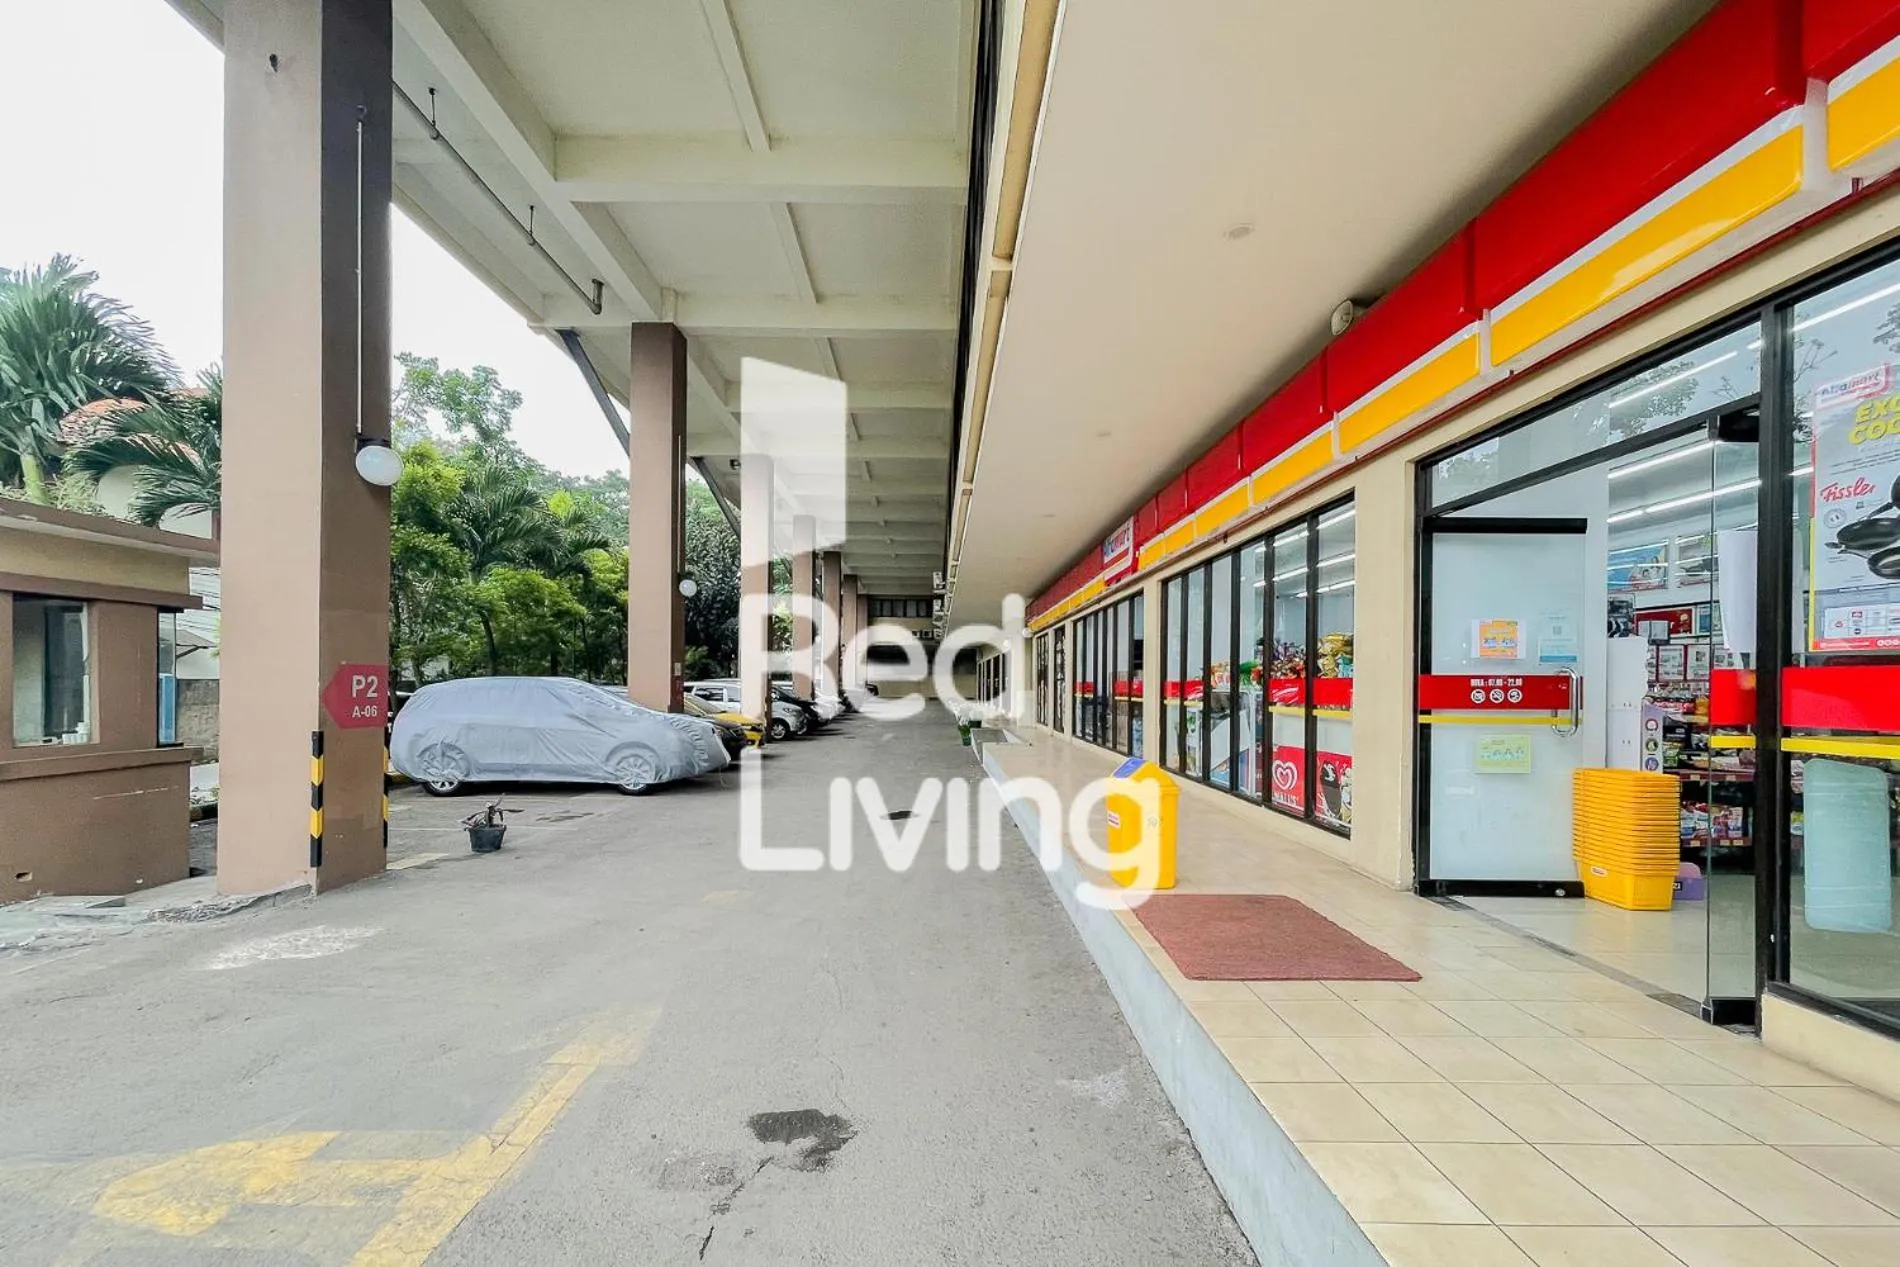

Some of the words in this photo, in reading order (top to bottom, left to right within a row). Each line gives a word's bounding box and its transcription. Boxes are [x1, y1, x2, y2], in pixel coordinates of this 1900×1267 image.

[1820, 476, 1877, 503] Fissler
[351, 675, 379, 698] P2
[352, 705, 378, 718] A-06
